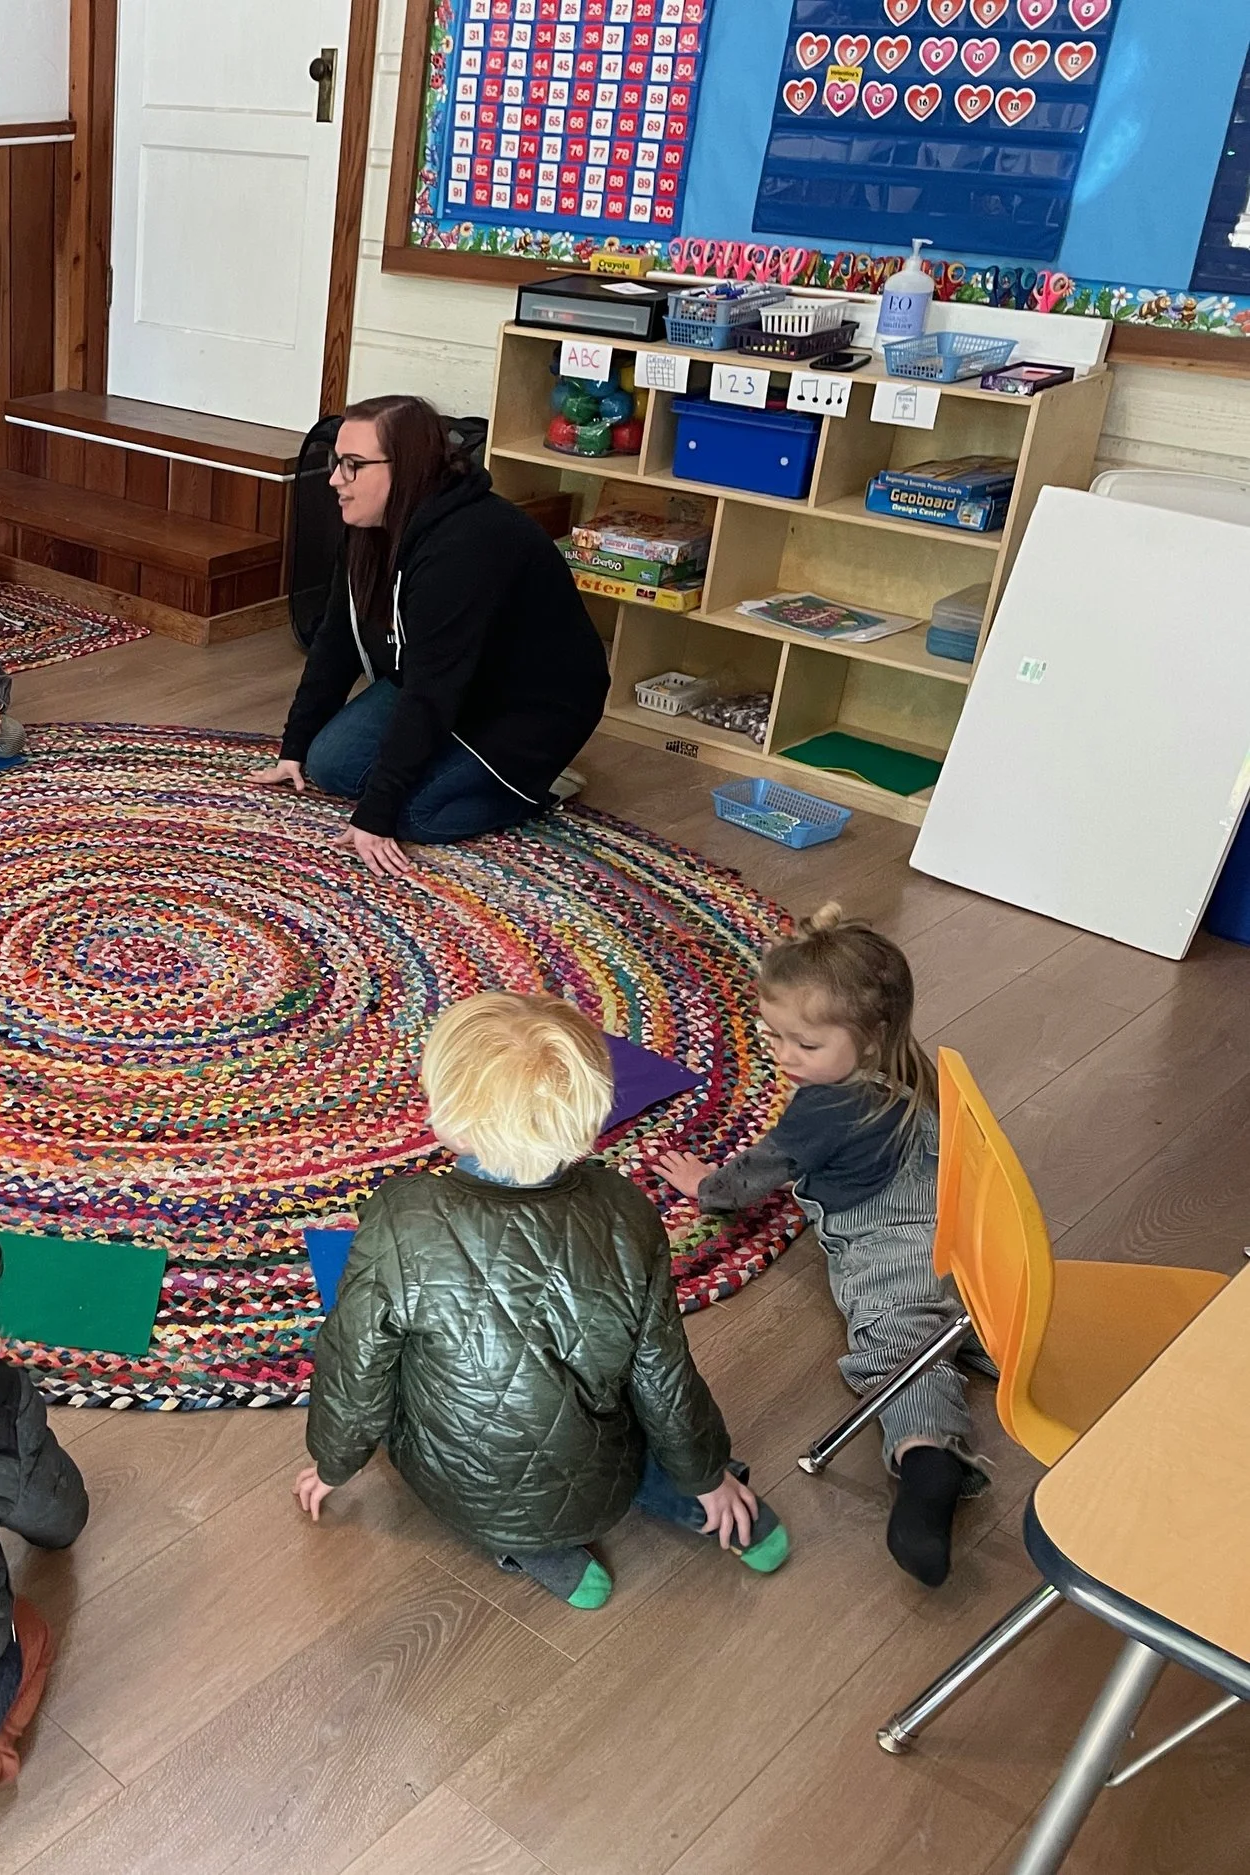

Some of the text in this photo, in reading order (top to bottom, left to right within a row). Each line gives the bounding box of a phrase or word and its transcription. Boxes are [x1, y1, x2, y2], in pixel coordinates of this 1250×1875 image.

[475, 1, 700, 18] 21 22 23 24 25 26 27 28 29 30
[900, 3, 1091, 15] 1 2 3 4 5
[469, 30, 695, 46] 31 32 33 34 35 36 37 38 39 40
[465, 57, 692, 76] 41 42 43 44 45 46 47 48 49 50
[849, 49, 855, 57] 7
[889, 50, 895, 59] 8
[935, 51, 941, 60] 9
[974, 53, 984, 62] 10
[1026, 55, 1033, 63] 11
[1070, 57, 1080, 65] 12
[461, 84, 686, 106] 51 52 53 54 55 56 57 58 59 60
[796, 92, 1020, 111] 13 14 15 16 17 18
[460, 110, 684, 135] 61 62 63 64 65 66 67 68 69 70
[459, 137, 680, 164] 71 72 73 74 75 76 77 78 79 80
[456, 163, 674, 191] 81 82 83 84 85 86 87 88 89 90
[452, 187, 674, 219] 91 92 93 94 95 96 97 98 99 100
[598, 260, 630, 270] Crayola
[889, 296, 912, 311] EO
[567, 346, 602, 370] ABC
[890, 488, 956, 511] Geoboard
[892, 504, 946, 518] Design Center
[574, 574, 626, 594] ister
[681, 741, 699, 752] ECR
